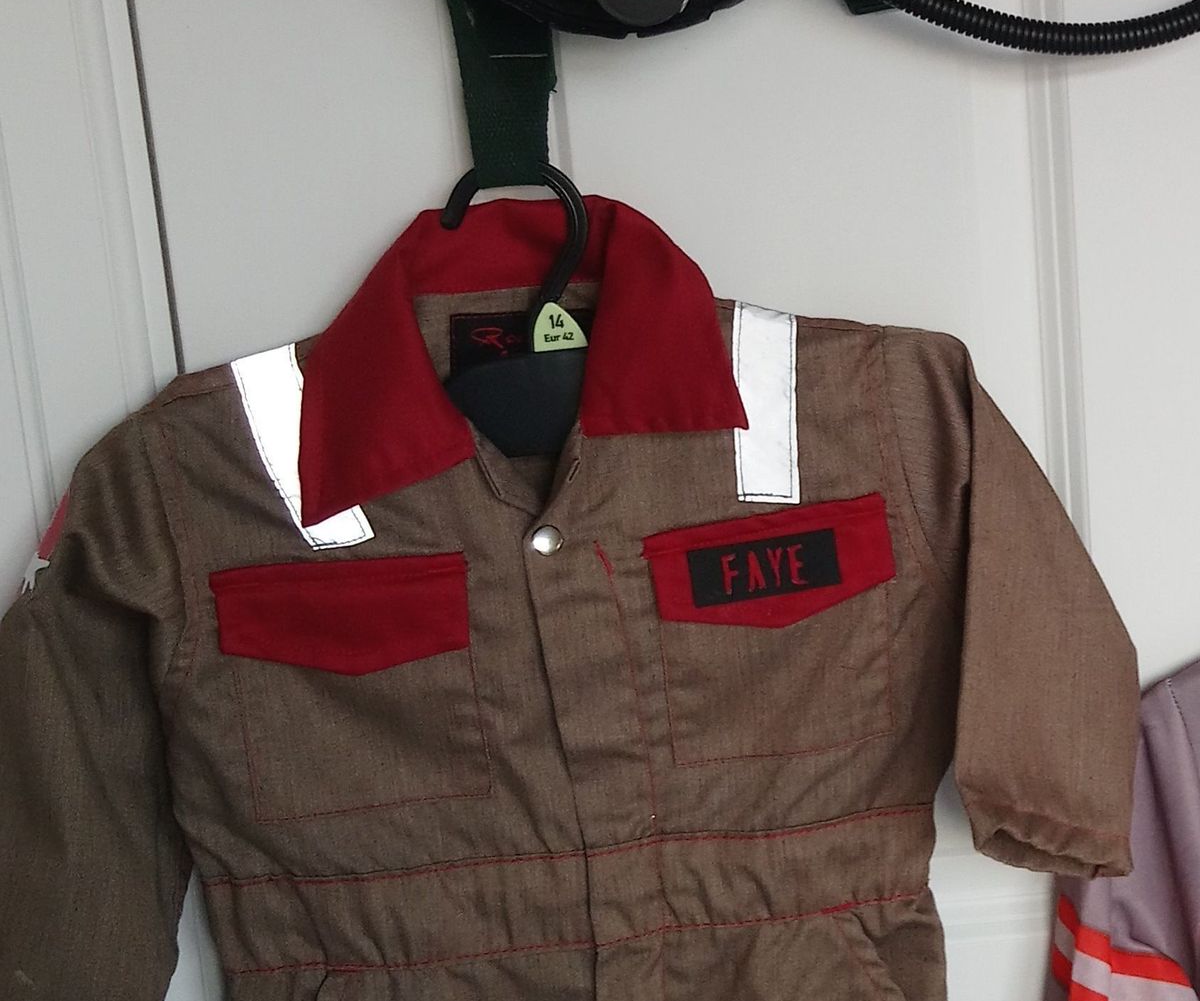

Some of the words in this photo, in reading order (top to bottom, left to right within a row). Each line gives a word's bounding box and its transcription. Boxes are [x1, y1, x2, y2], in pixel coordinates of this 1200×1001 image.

[549, 313, 564, 329] 14
[544, 332, 561, 343] Eur
[562, 331, 574, 341] 42
[720, 543, 808, 595] FAYE
